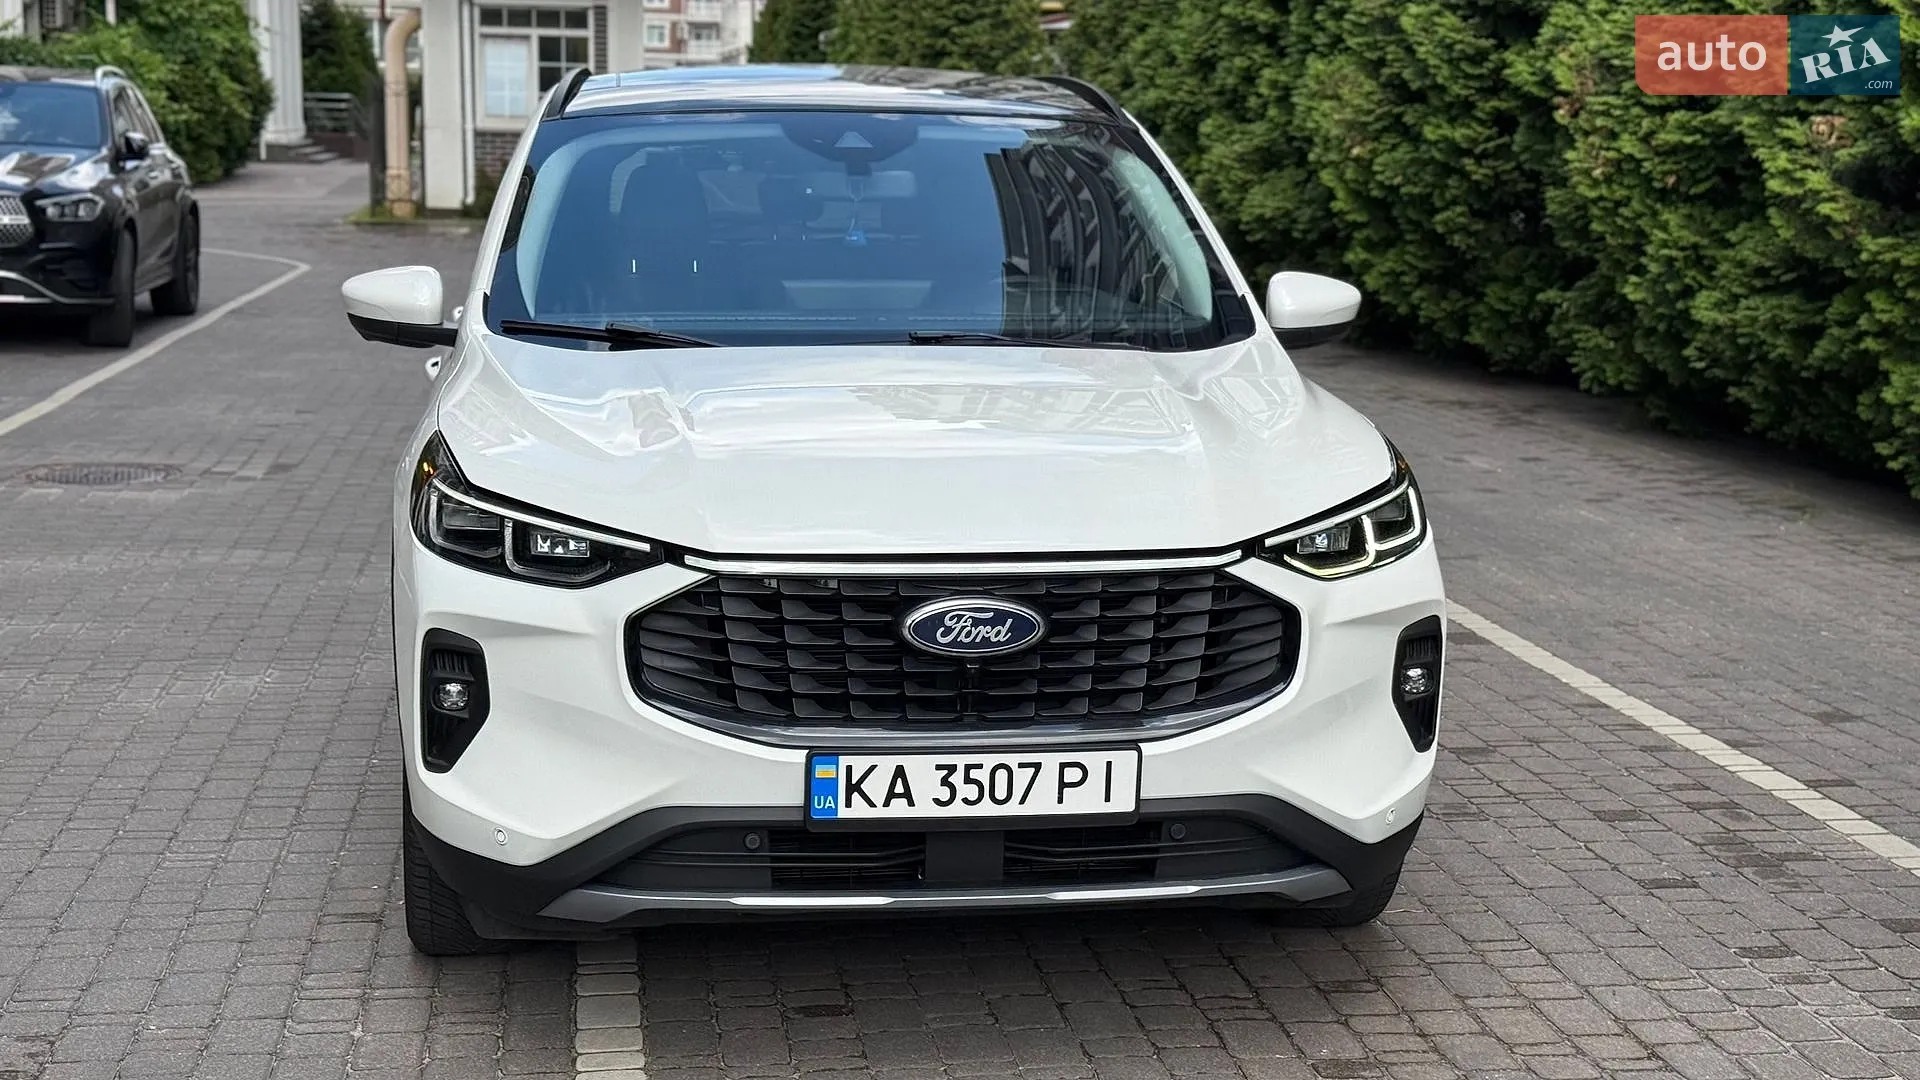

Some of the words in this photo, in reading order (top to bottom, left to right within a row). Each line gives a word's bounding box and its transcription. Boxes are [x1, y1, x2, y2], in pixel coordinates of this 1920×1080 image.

[936, 611, 1013, 643] Ford
[844, 764, 916, 808] KA
[931, 762, 1043, 807] 3507
[814, 796, 836, 809] UA
